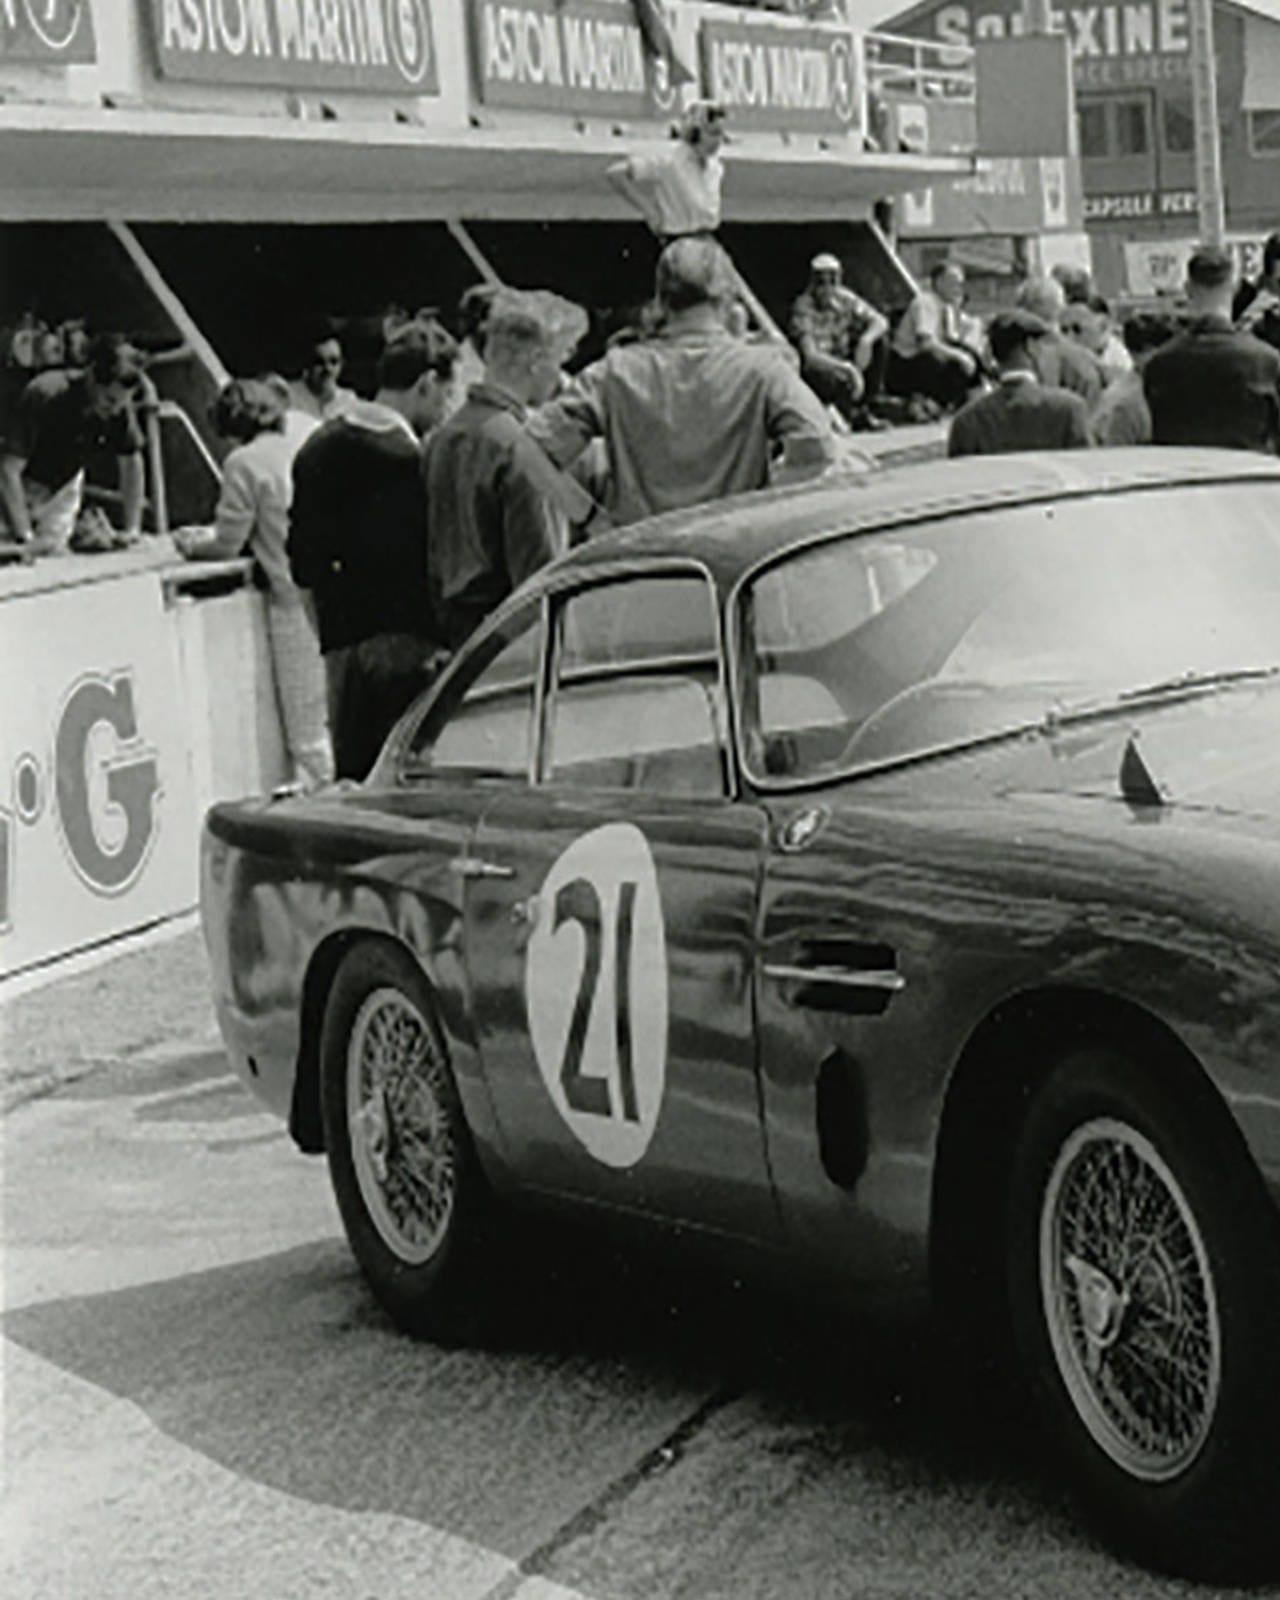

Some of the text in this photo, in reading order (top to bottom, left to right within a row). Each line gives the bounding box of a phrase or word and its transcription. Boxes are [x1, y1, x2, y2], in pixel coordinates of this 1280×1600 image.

[162, 0, 271, 56] ASTON
[277, 0, 389, 65] MARTIN
[484, 3, 563, 86] ASTON
[563, 13, 646, 93] MARTIN
[935, 0, 1188, 66] SOEXINE
[712, 41, 767, 107] ASTON
[768, 46, 829, 109] MARTIN
[1161, 191, 1199, 213] VER
[553, 876, 641, 1124] 21
